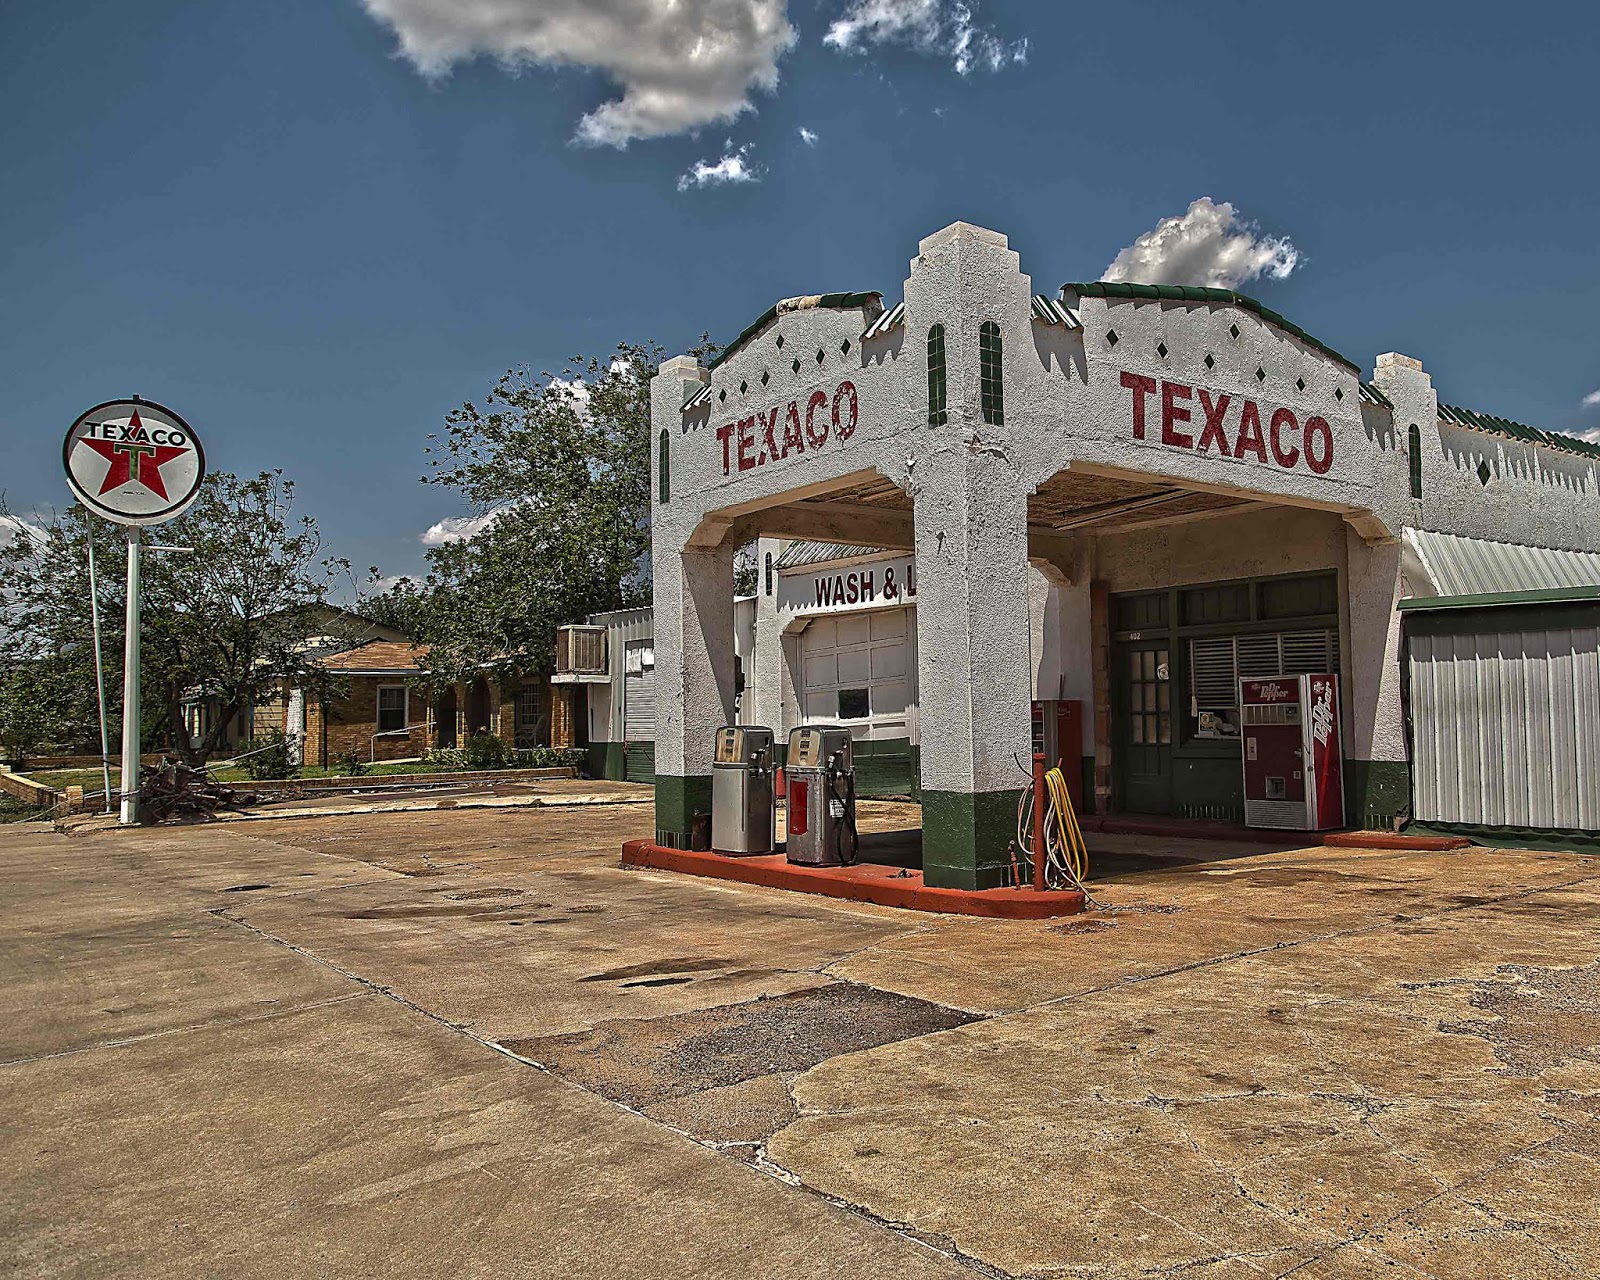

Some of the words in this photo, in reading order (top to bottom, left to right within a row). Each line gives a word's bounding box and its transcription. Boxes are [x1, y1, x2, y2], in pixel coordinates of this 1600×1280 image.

[84, 421, 187, 446] TEXACO
[716, 381, 859, 477] TEXACO
[1119, 370, 1334, 475] TEXACO
[113, 443, 157, 482] T
[814, 570, 874, 608] WASH
[883, 566, 899, 600] &
[1259, 685, 1289, 701] Pepper
[1268, 682, 1281, 692] Dr
[1312, 695, 1324, 725] Dr
[1313, 681, 1334, 748] Pepper
